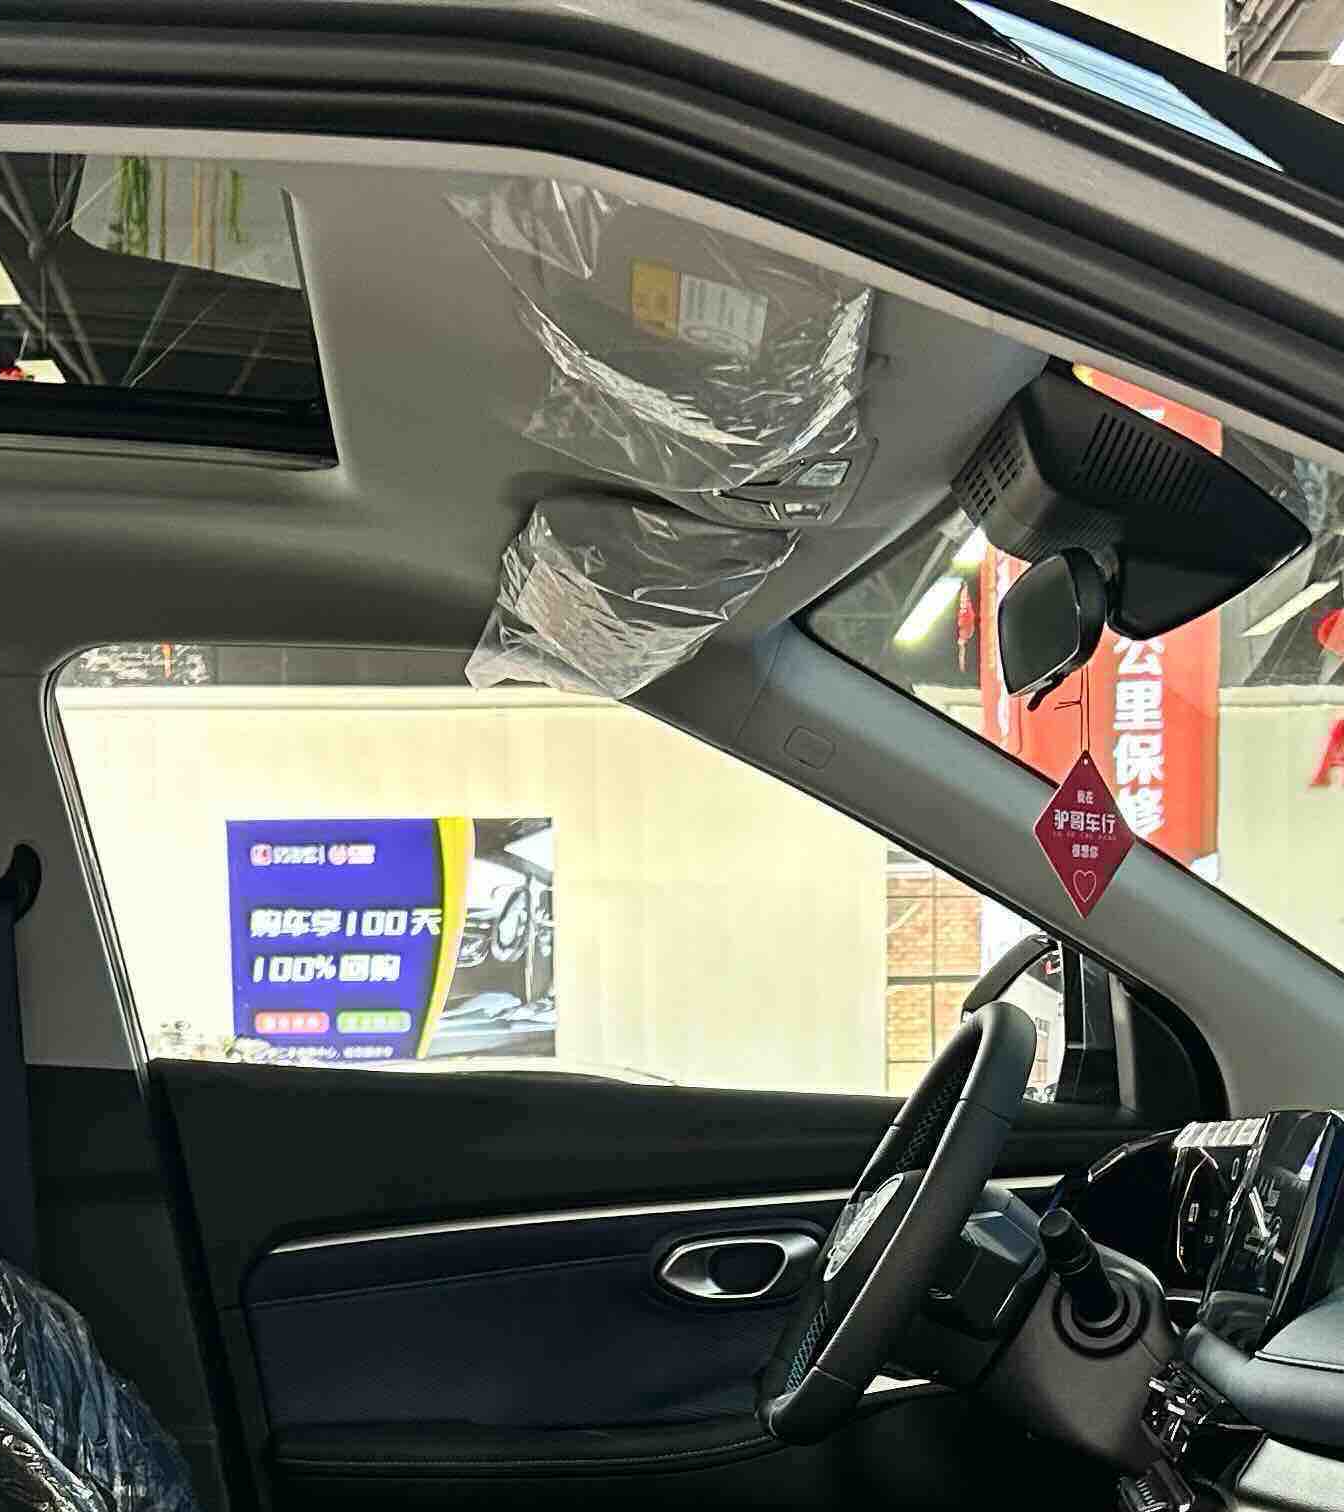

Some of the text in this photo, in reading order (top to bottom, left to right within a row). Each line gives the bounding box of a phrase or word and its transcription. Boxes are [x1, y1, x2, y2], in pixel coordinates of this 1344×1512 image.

[1112, 638, 1166, 838] 公里保修
[1054, 809, 1116, 834] 驴哥车行
